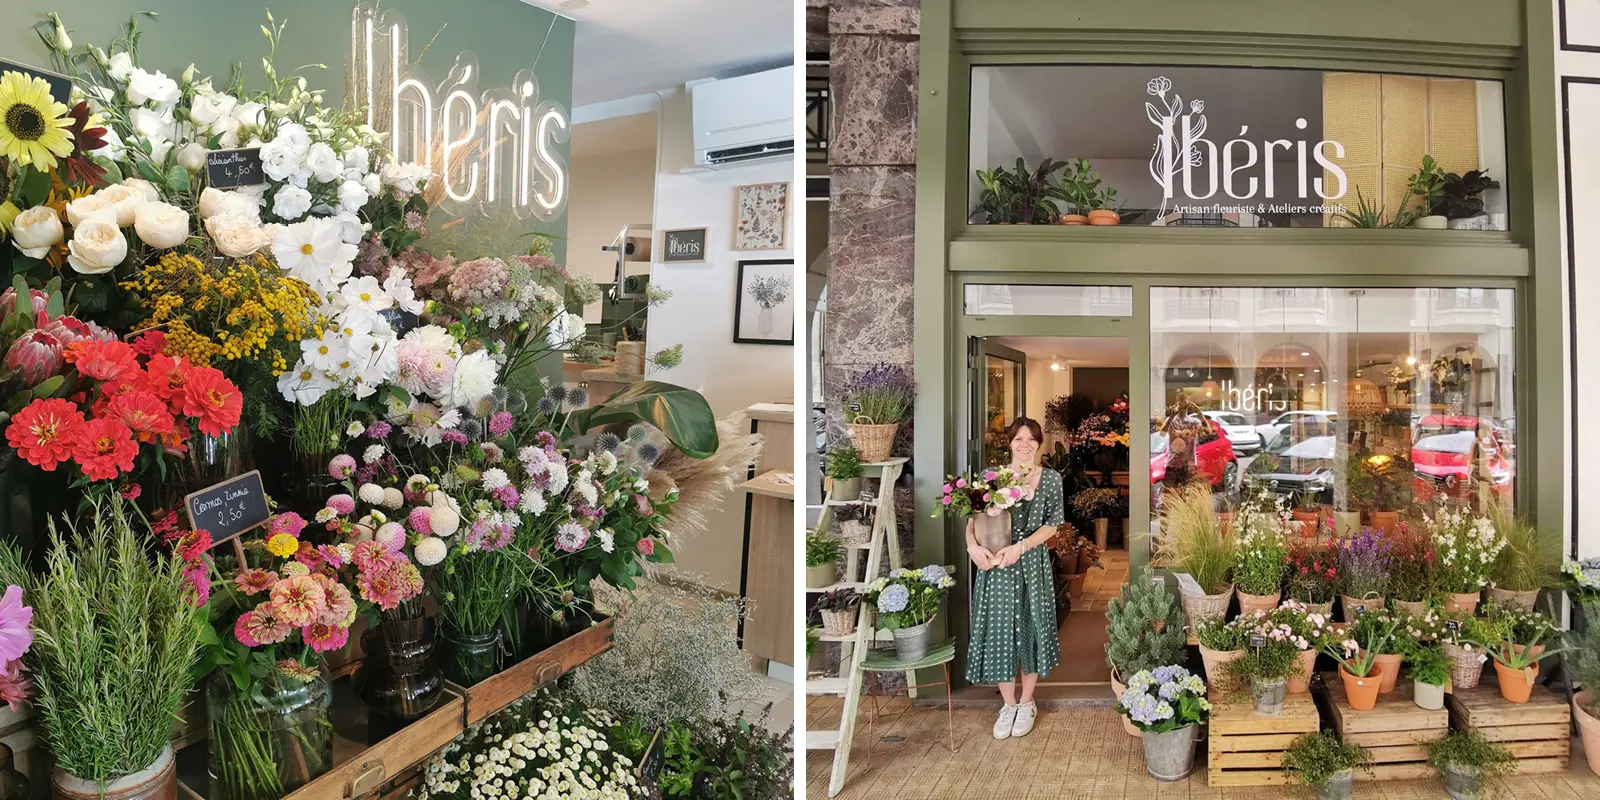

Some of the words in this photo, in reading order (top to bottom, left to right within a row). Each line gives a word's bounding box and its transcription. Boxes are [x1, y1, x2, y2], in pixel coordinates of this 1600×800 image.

[1162, 115, 1348, 201] Ibéris
[1173, 204, 1210, 214] Artisan
[1213, 203, 1255, 214] fleuriste
[1257, 203, 1266, 214] &
[1268, 203, 1307, 214] Ateliers
[1309, 203, 1347, 214] créatifs
[670, 239, 700, 254] Ibéris
